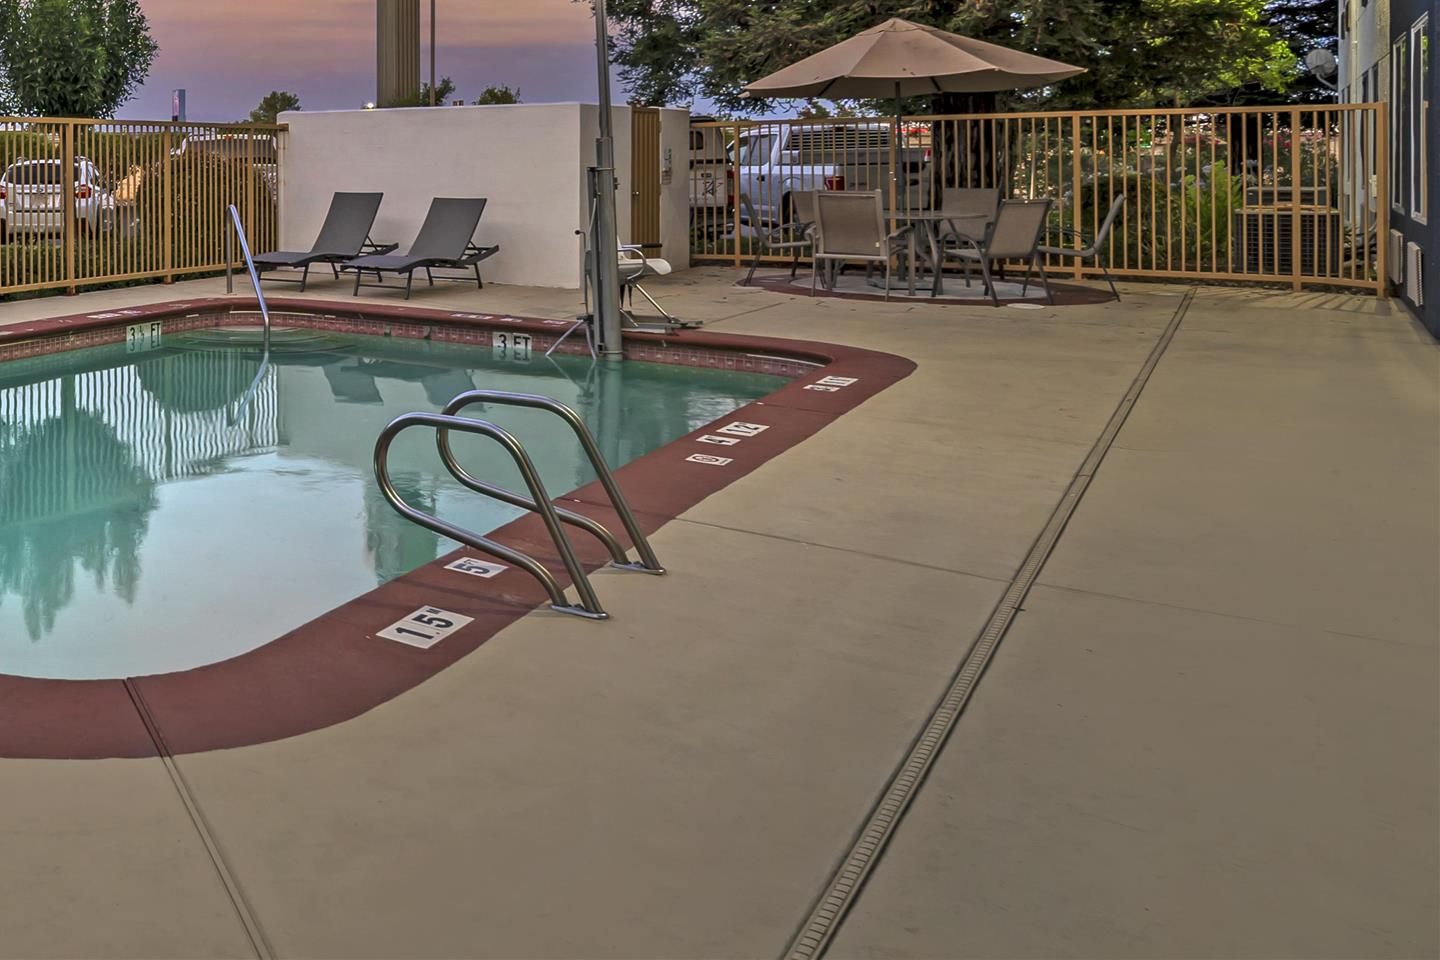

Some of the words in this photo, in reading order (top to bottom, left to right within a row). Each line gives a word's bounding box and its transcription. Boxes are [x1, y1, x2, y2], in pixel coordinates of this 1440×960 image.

[151, 322, 161, 338] FT
[498, 334, 507, 348] 3
[513, 336, 530, 348] FT
[453, 563, 490, 574] 5
